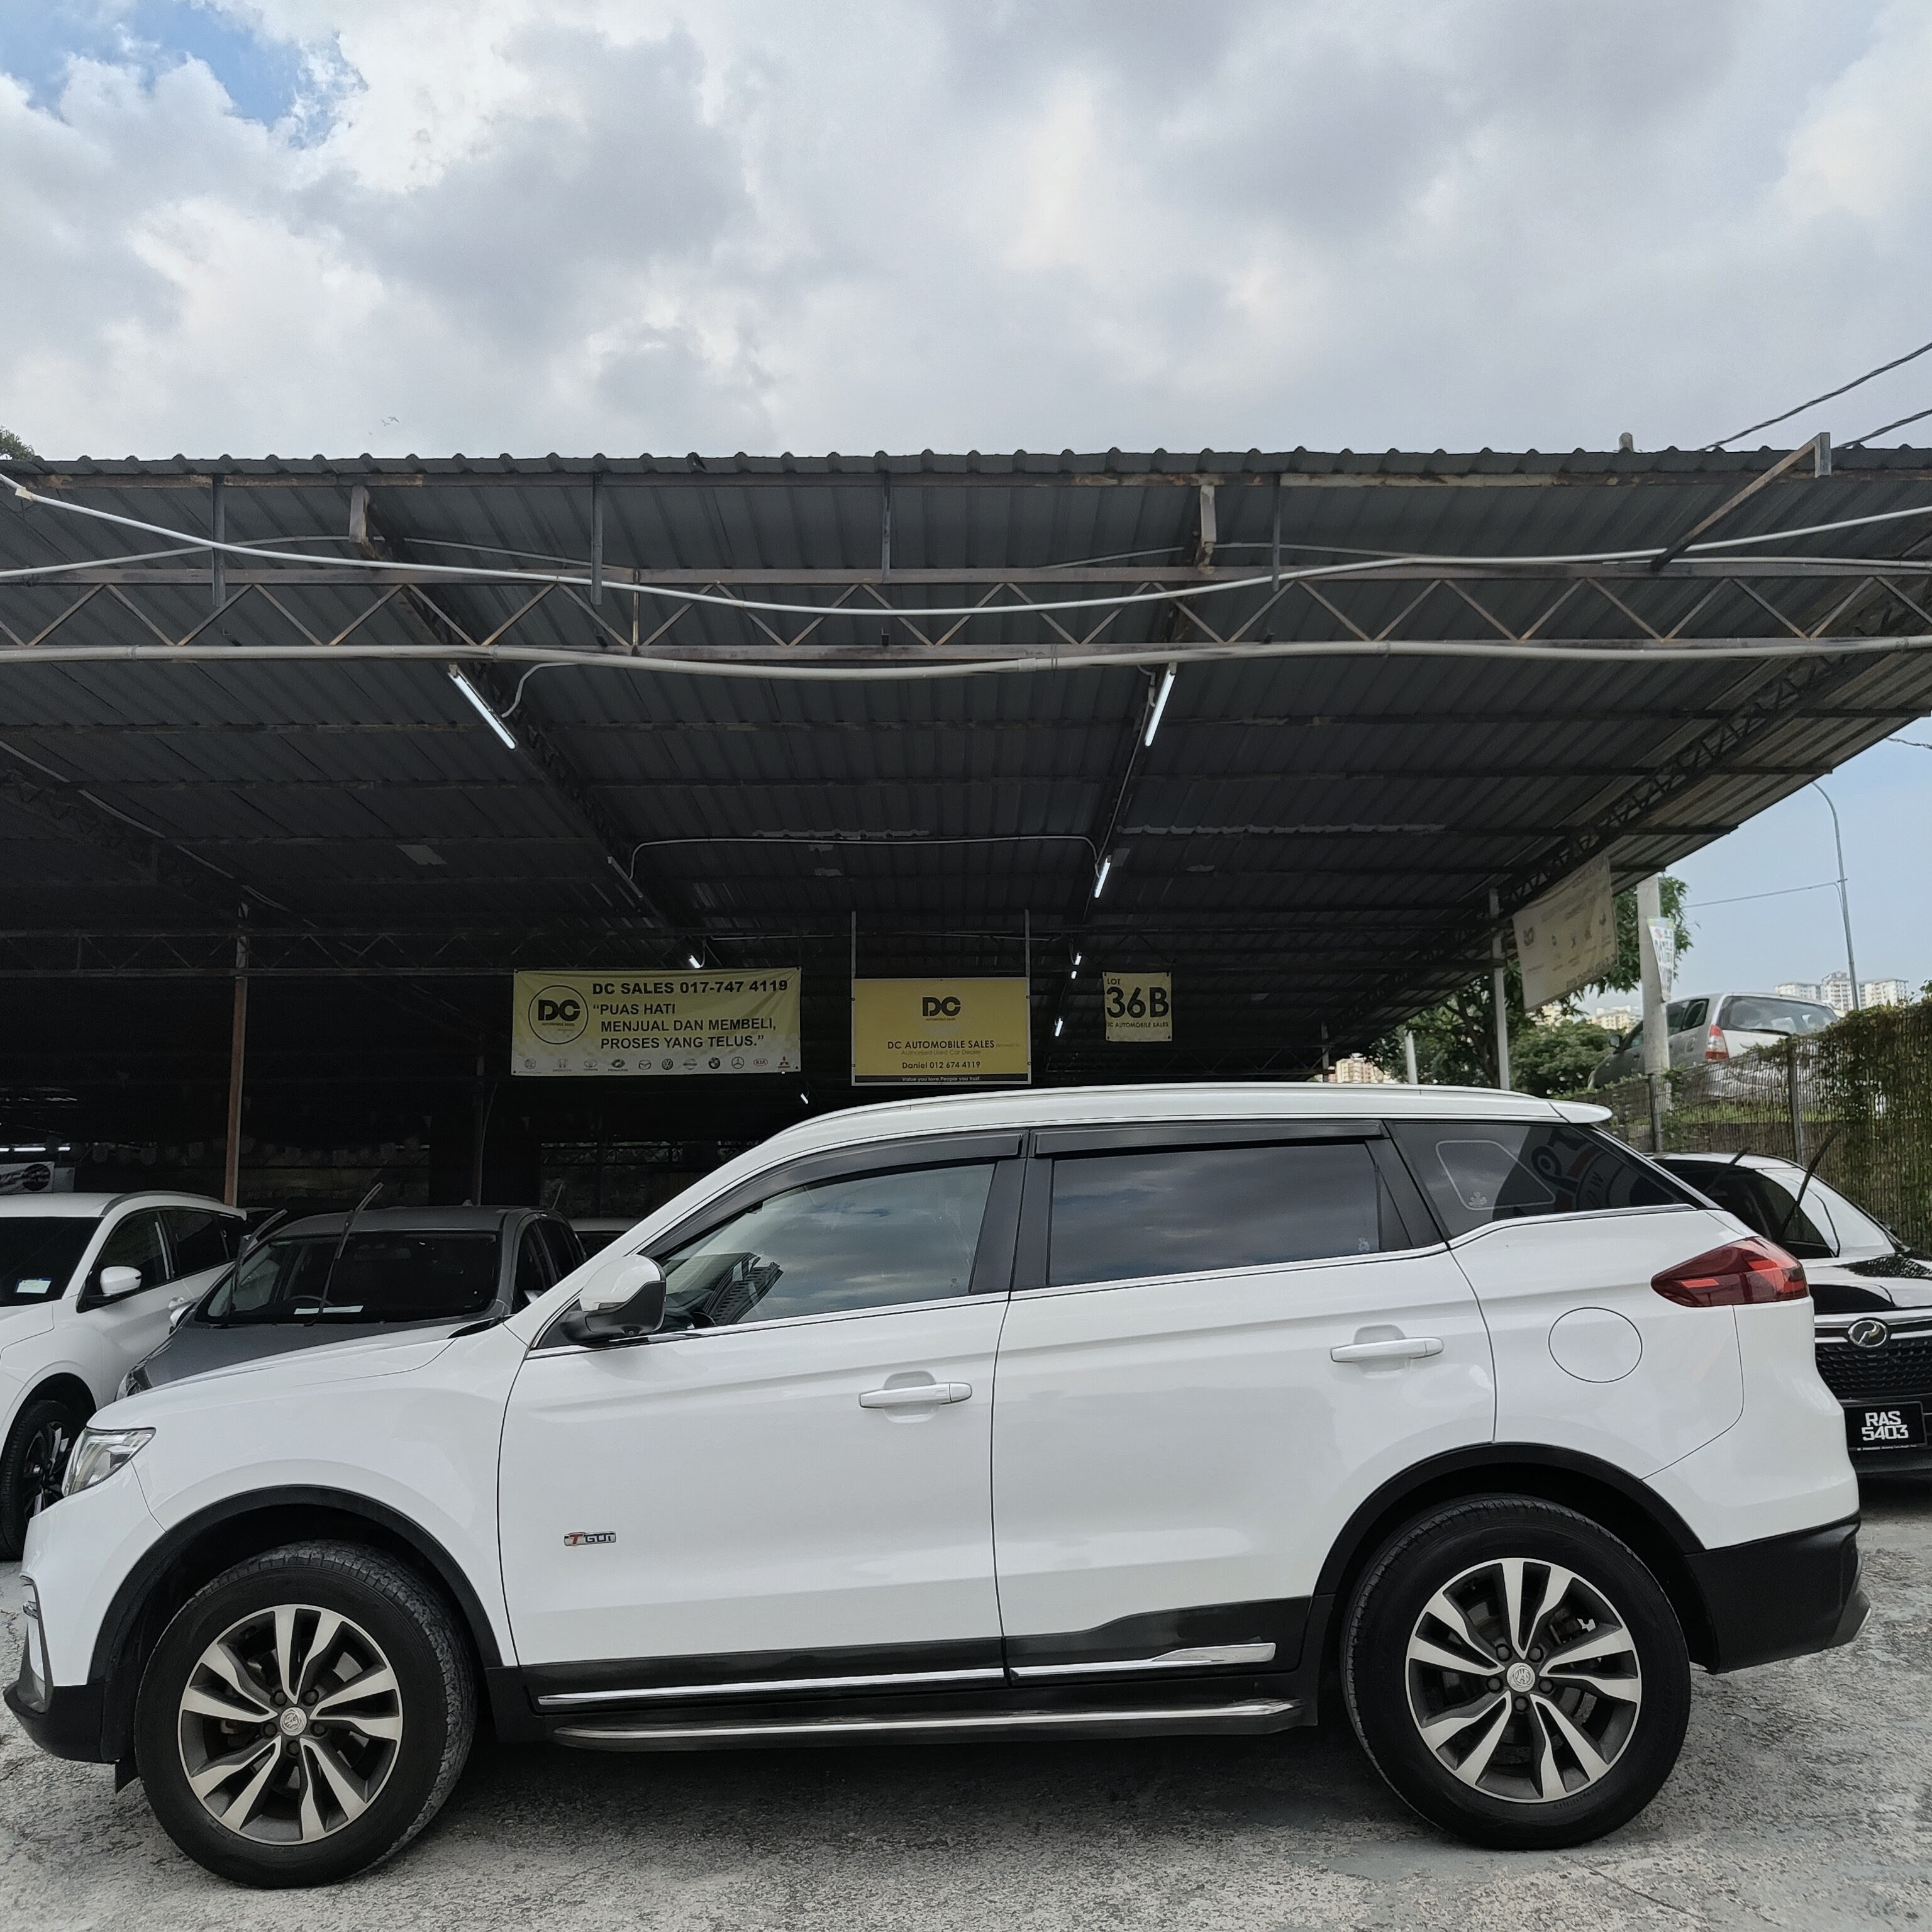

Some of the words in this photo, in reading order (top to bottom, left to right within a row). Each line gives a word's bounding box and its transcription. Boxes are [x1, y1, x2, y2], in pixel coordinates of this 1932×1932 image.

[592, 983, 615, 994] DC
[621, 982, 674, 994] SALES
[680, 981, 744, 993] 017-747
[749, 980, 787, 992] 4119
[644, 1004, 675, 1014] HATI
[923, 996, 961, 1016] DC
[1106, 987, 1169, 1018] 36B
[538, 999, 580, 1021] DC
[601, 1020, 669, 1032] MENJUAL
[674, 1019, 703, 1031] DAN
[709, 1018, 776, 1031] MEMBELI,
[601, 1038, 659, 1049] PROSES
[664, 1037, 703, 1048] YANG
[887, 1041, 901, 1049] DC
[905, 1040, 965, 1049] AUTOMOBILE
[968, 1040, 994, 1048] SALES
[1865, 1411, 1902, 1426] RAS
[1861, 1424, 1909, 1441] 5403
